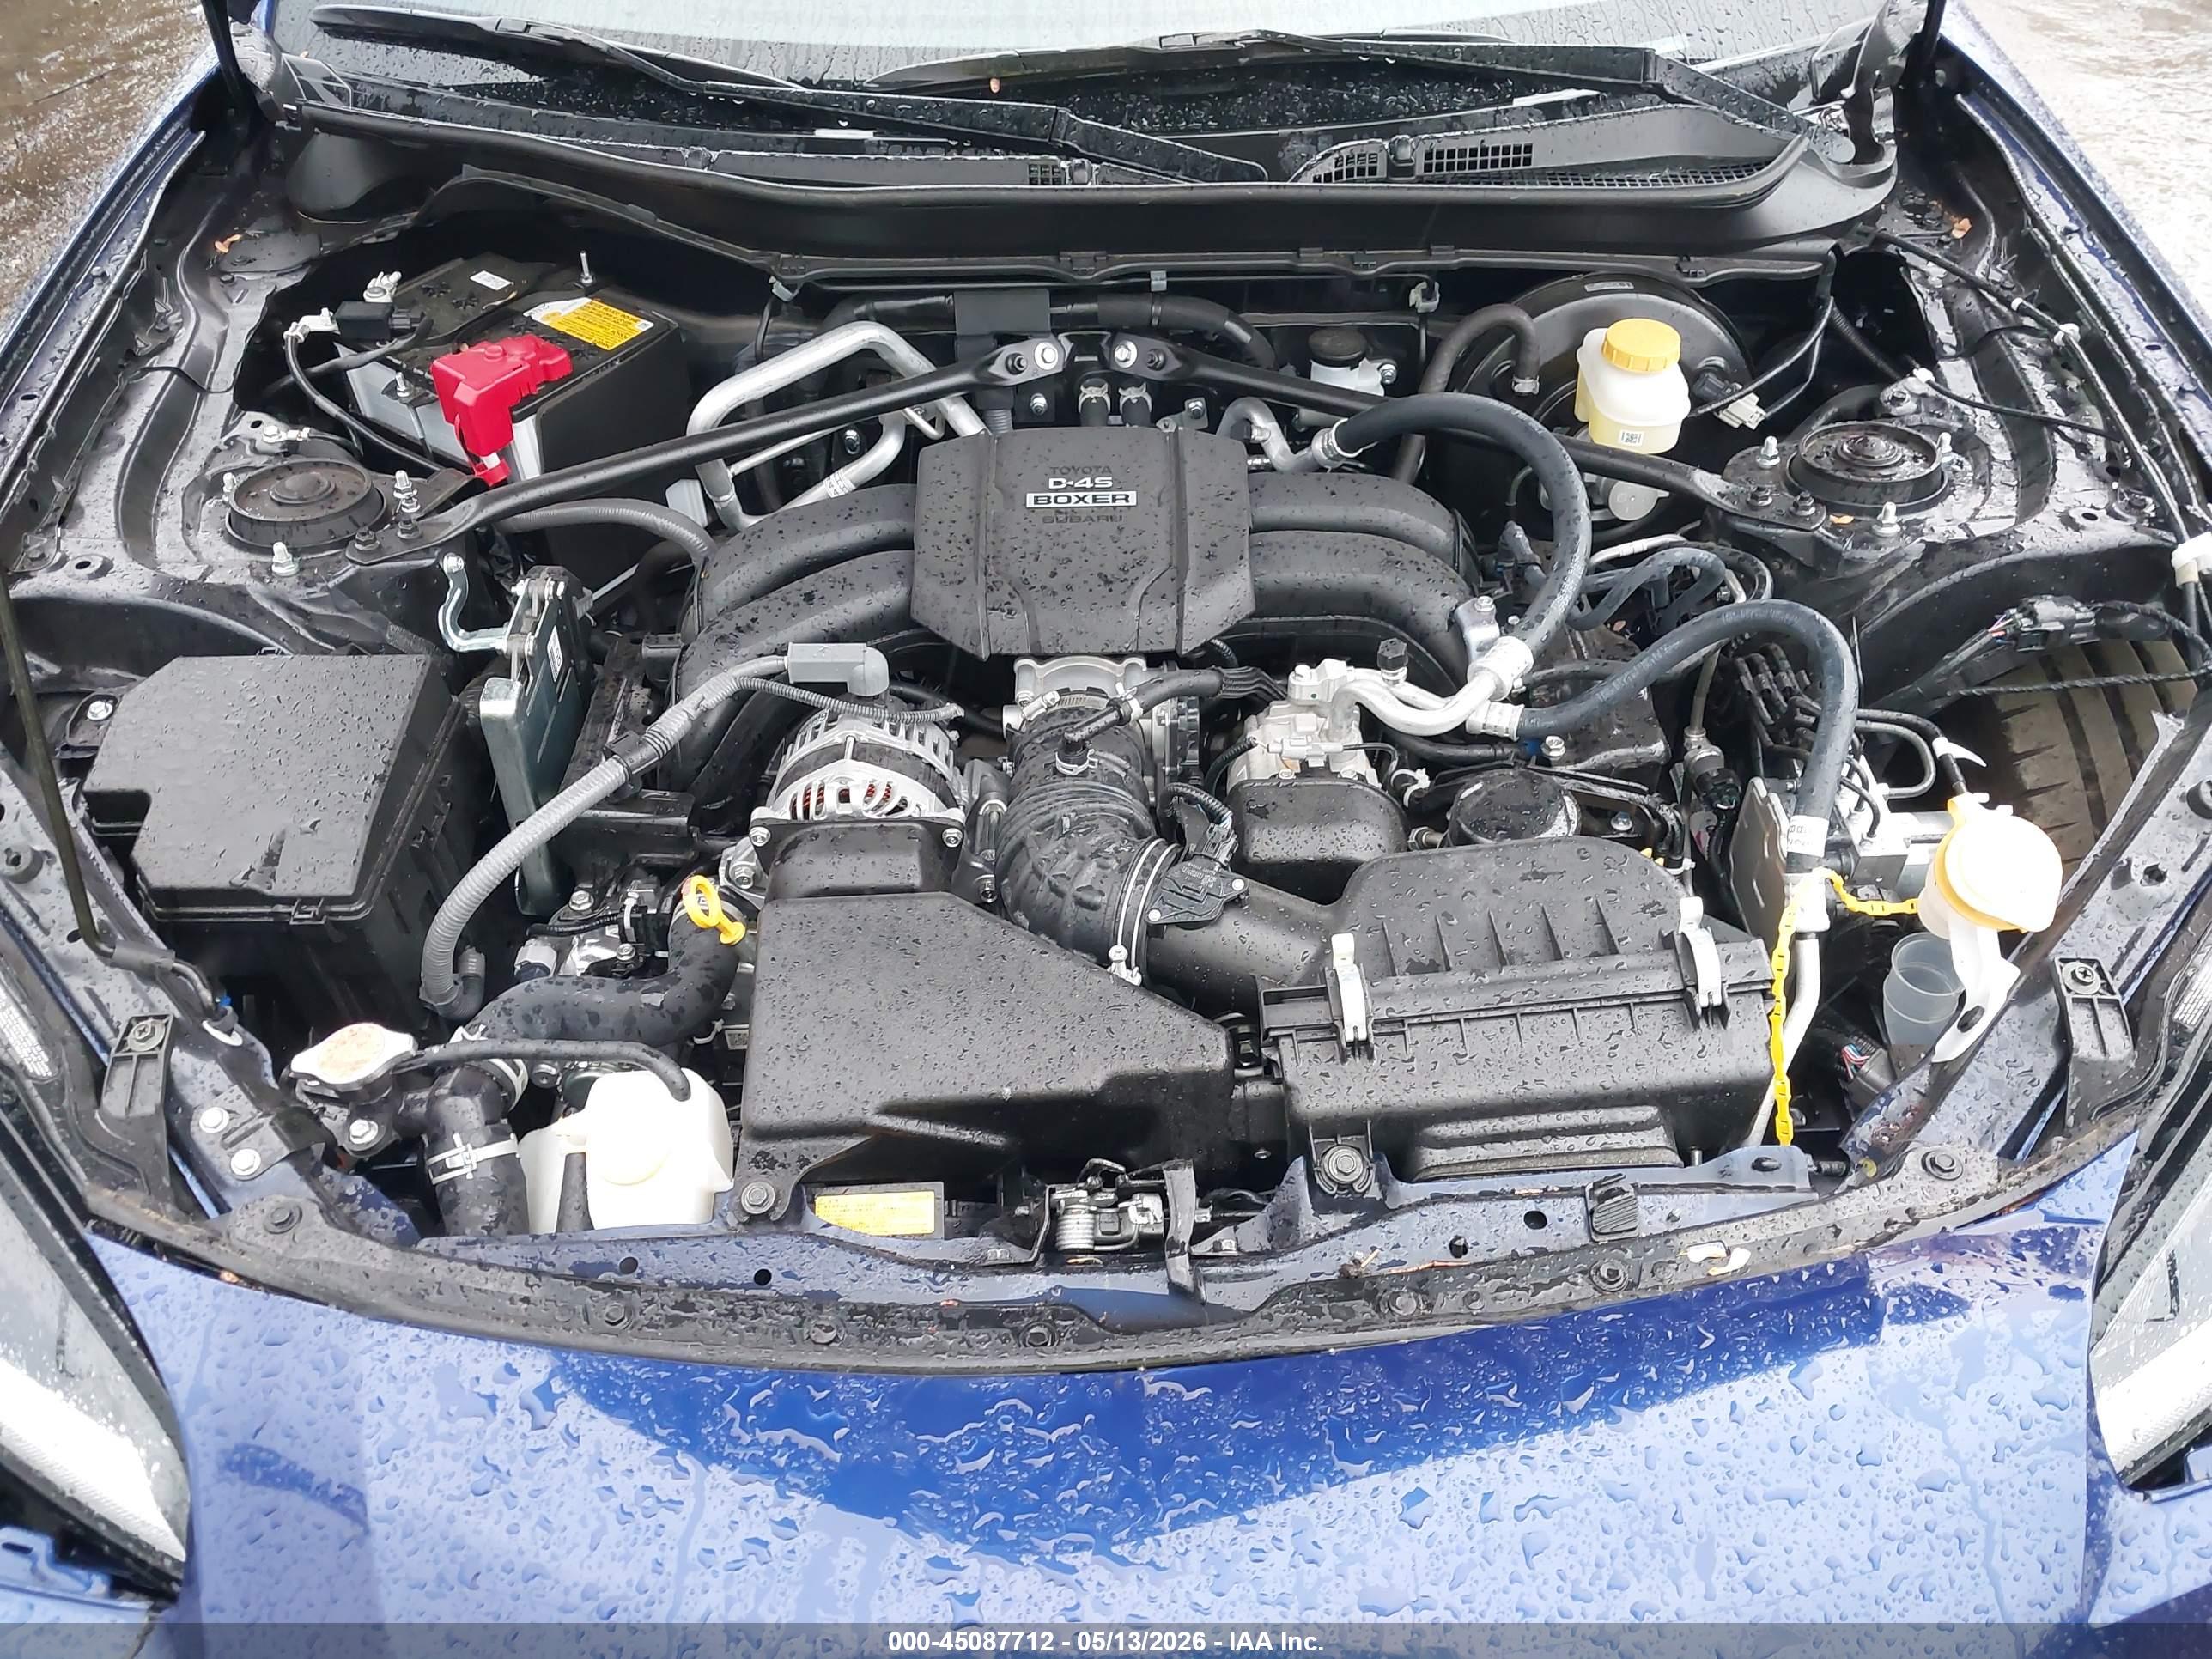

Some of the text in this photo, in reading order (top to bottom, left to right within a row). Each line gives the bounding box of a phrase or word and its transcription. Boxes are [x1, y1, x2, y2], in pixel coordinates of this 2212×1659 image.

[1049, 465, 1112, 475] TOYOTA
[1048, 477, 1113, 489] D-4S
[1033, 494, 1130, 505] BOXER
